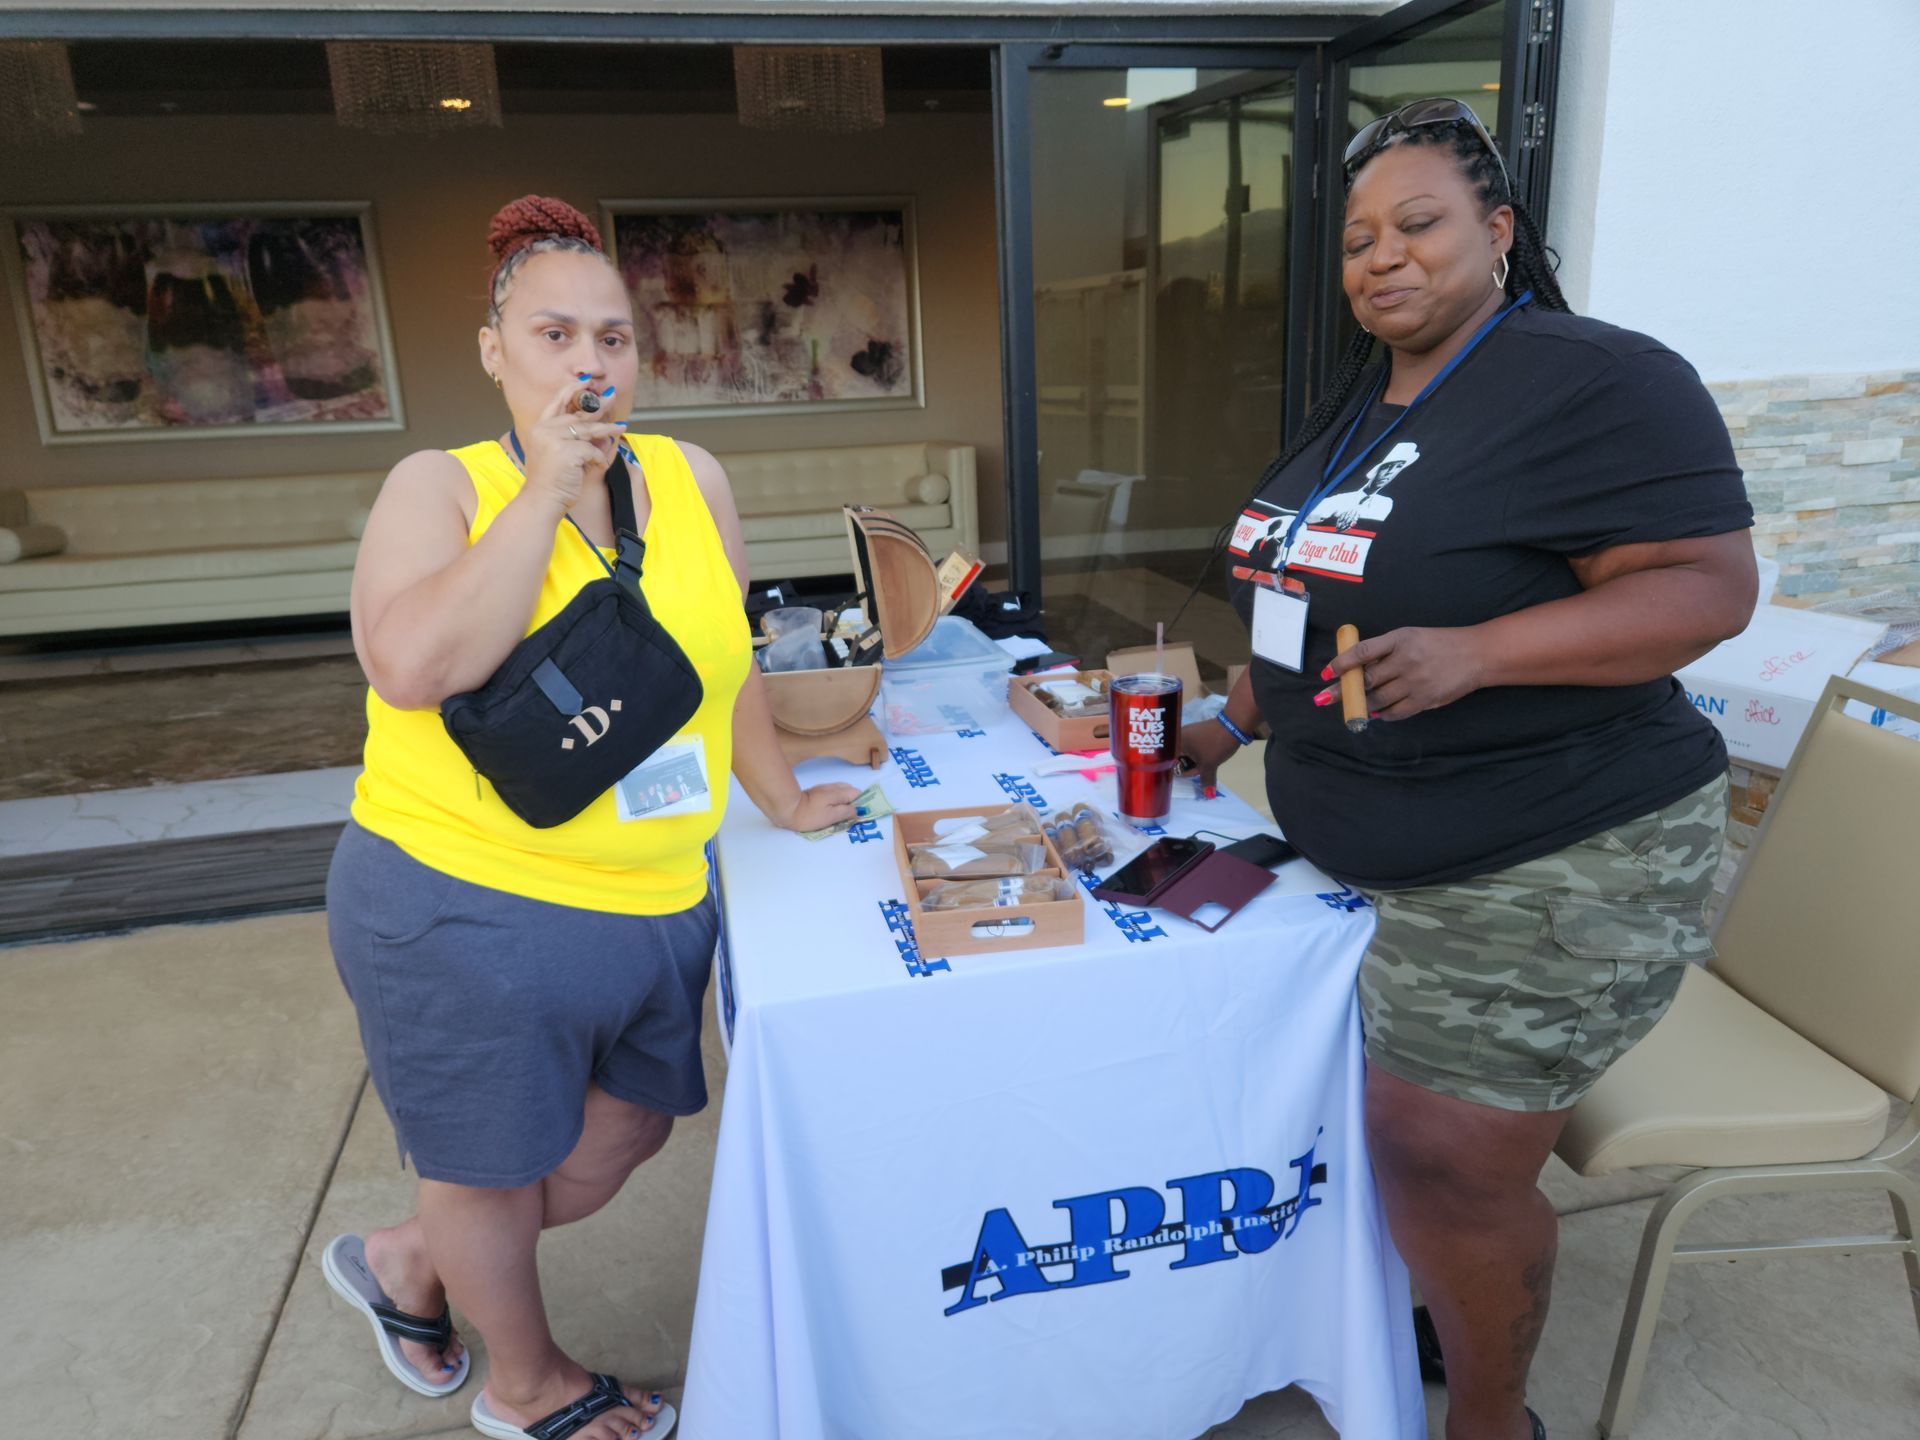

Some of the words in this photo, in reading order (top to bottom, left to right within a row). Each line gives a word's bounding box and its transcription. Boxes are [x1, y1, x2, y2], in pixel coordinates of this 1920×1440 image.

[1298, 540, 1328, 563] Cigar
[1329, 542, 1360, 565] Club
[1759, 647, 1816, 682] office
[568, 705, 611, 747] D
[1129, 707, 1166, 721] FAT
[1129, 721, 1165, 733] TUES
[1744, 699, 1781, 725] office
[889, 747, 941, 788] APRI
[992, 773, 1052, 816] APR
[944, 1126, 1323, 1317] APRI
[980, 1251, 1009, 1276] A.
[1016, 1243, 1096, 1269] Philip
[1103, 1219, 1224, 1255] Randolph
